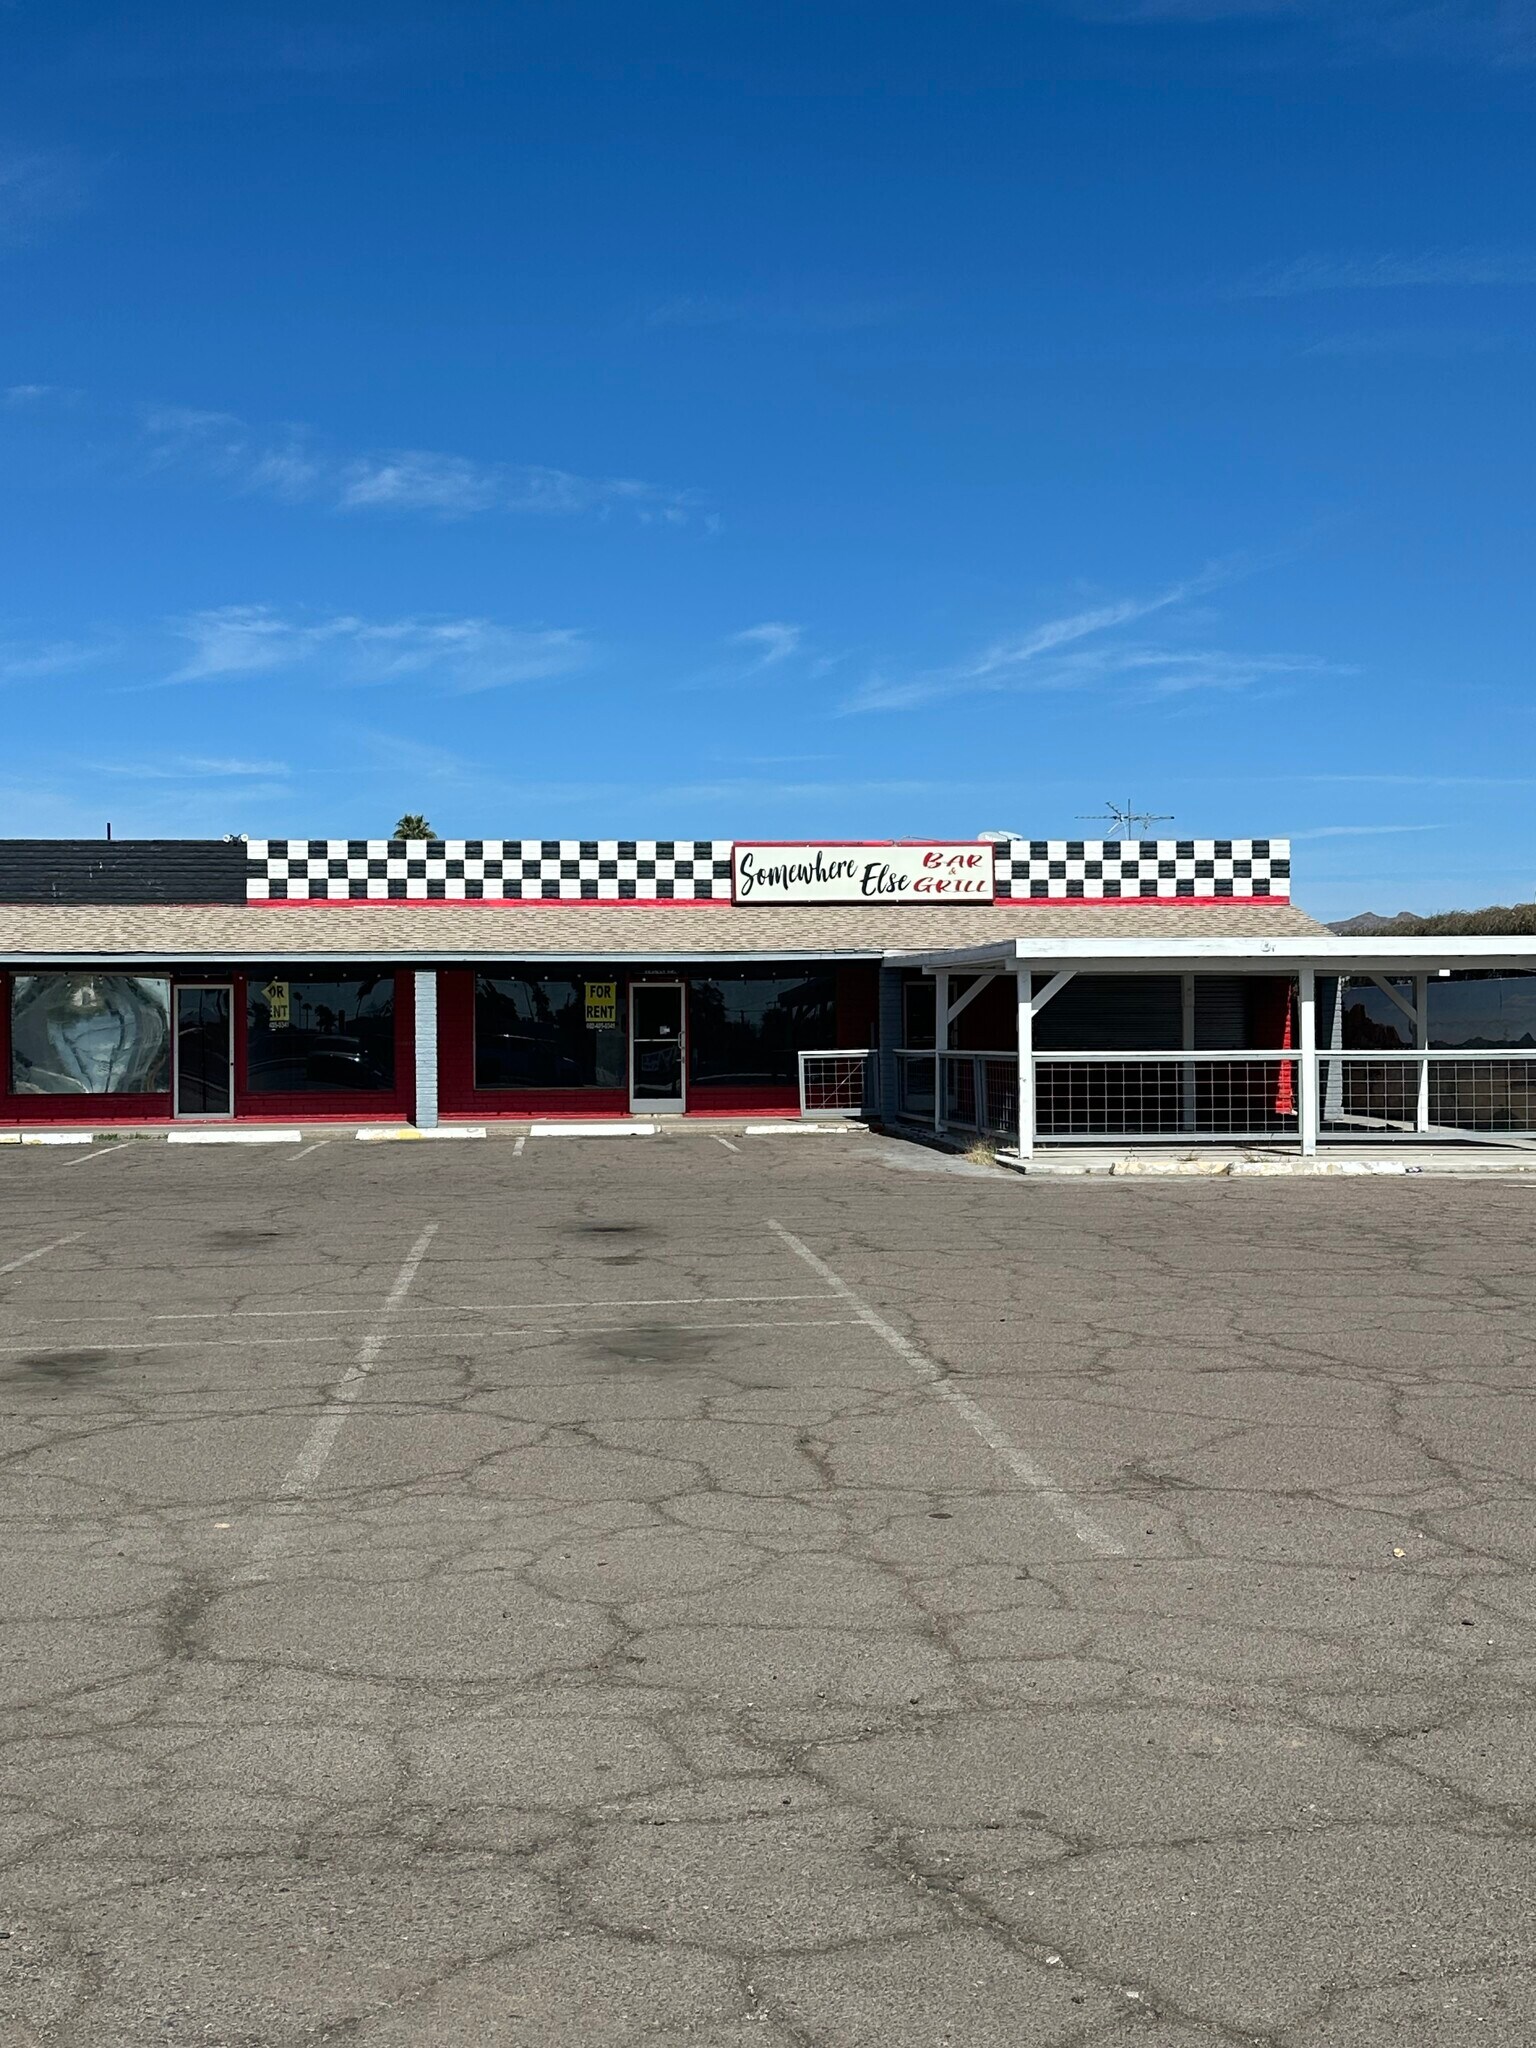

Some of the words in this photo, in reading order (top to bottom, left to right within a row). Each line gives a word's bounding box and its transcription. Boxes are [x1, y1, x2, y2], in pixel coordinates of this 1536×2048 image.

[922, 851, 983, 868] BAR
[740, 851, 858, 896] Somewhere
[860, 862, 911, 896] Else
[948, 868, 957, 876] &
[913, 876, 989, 893] GRILL
[268, 985, 284, 998] OR
[590, 985, 611, 998] FOR
[270, 1005, 288, 1018] ENT
[587, 1006, 614, 1018] RENT
